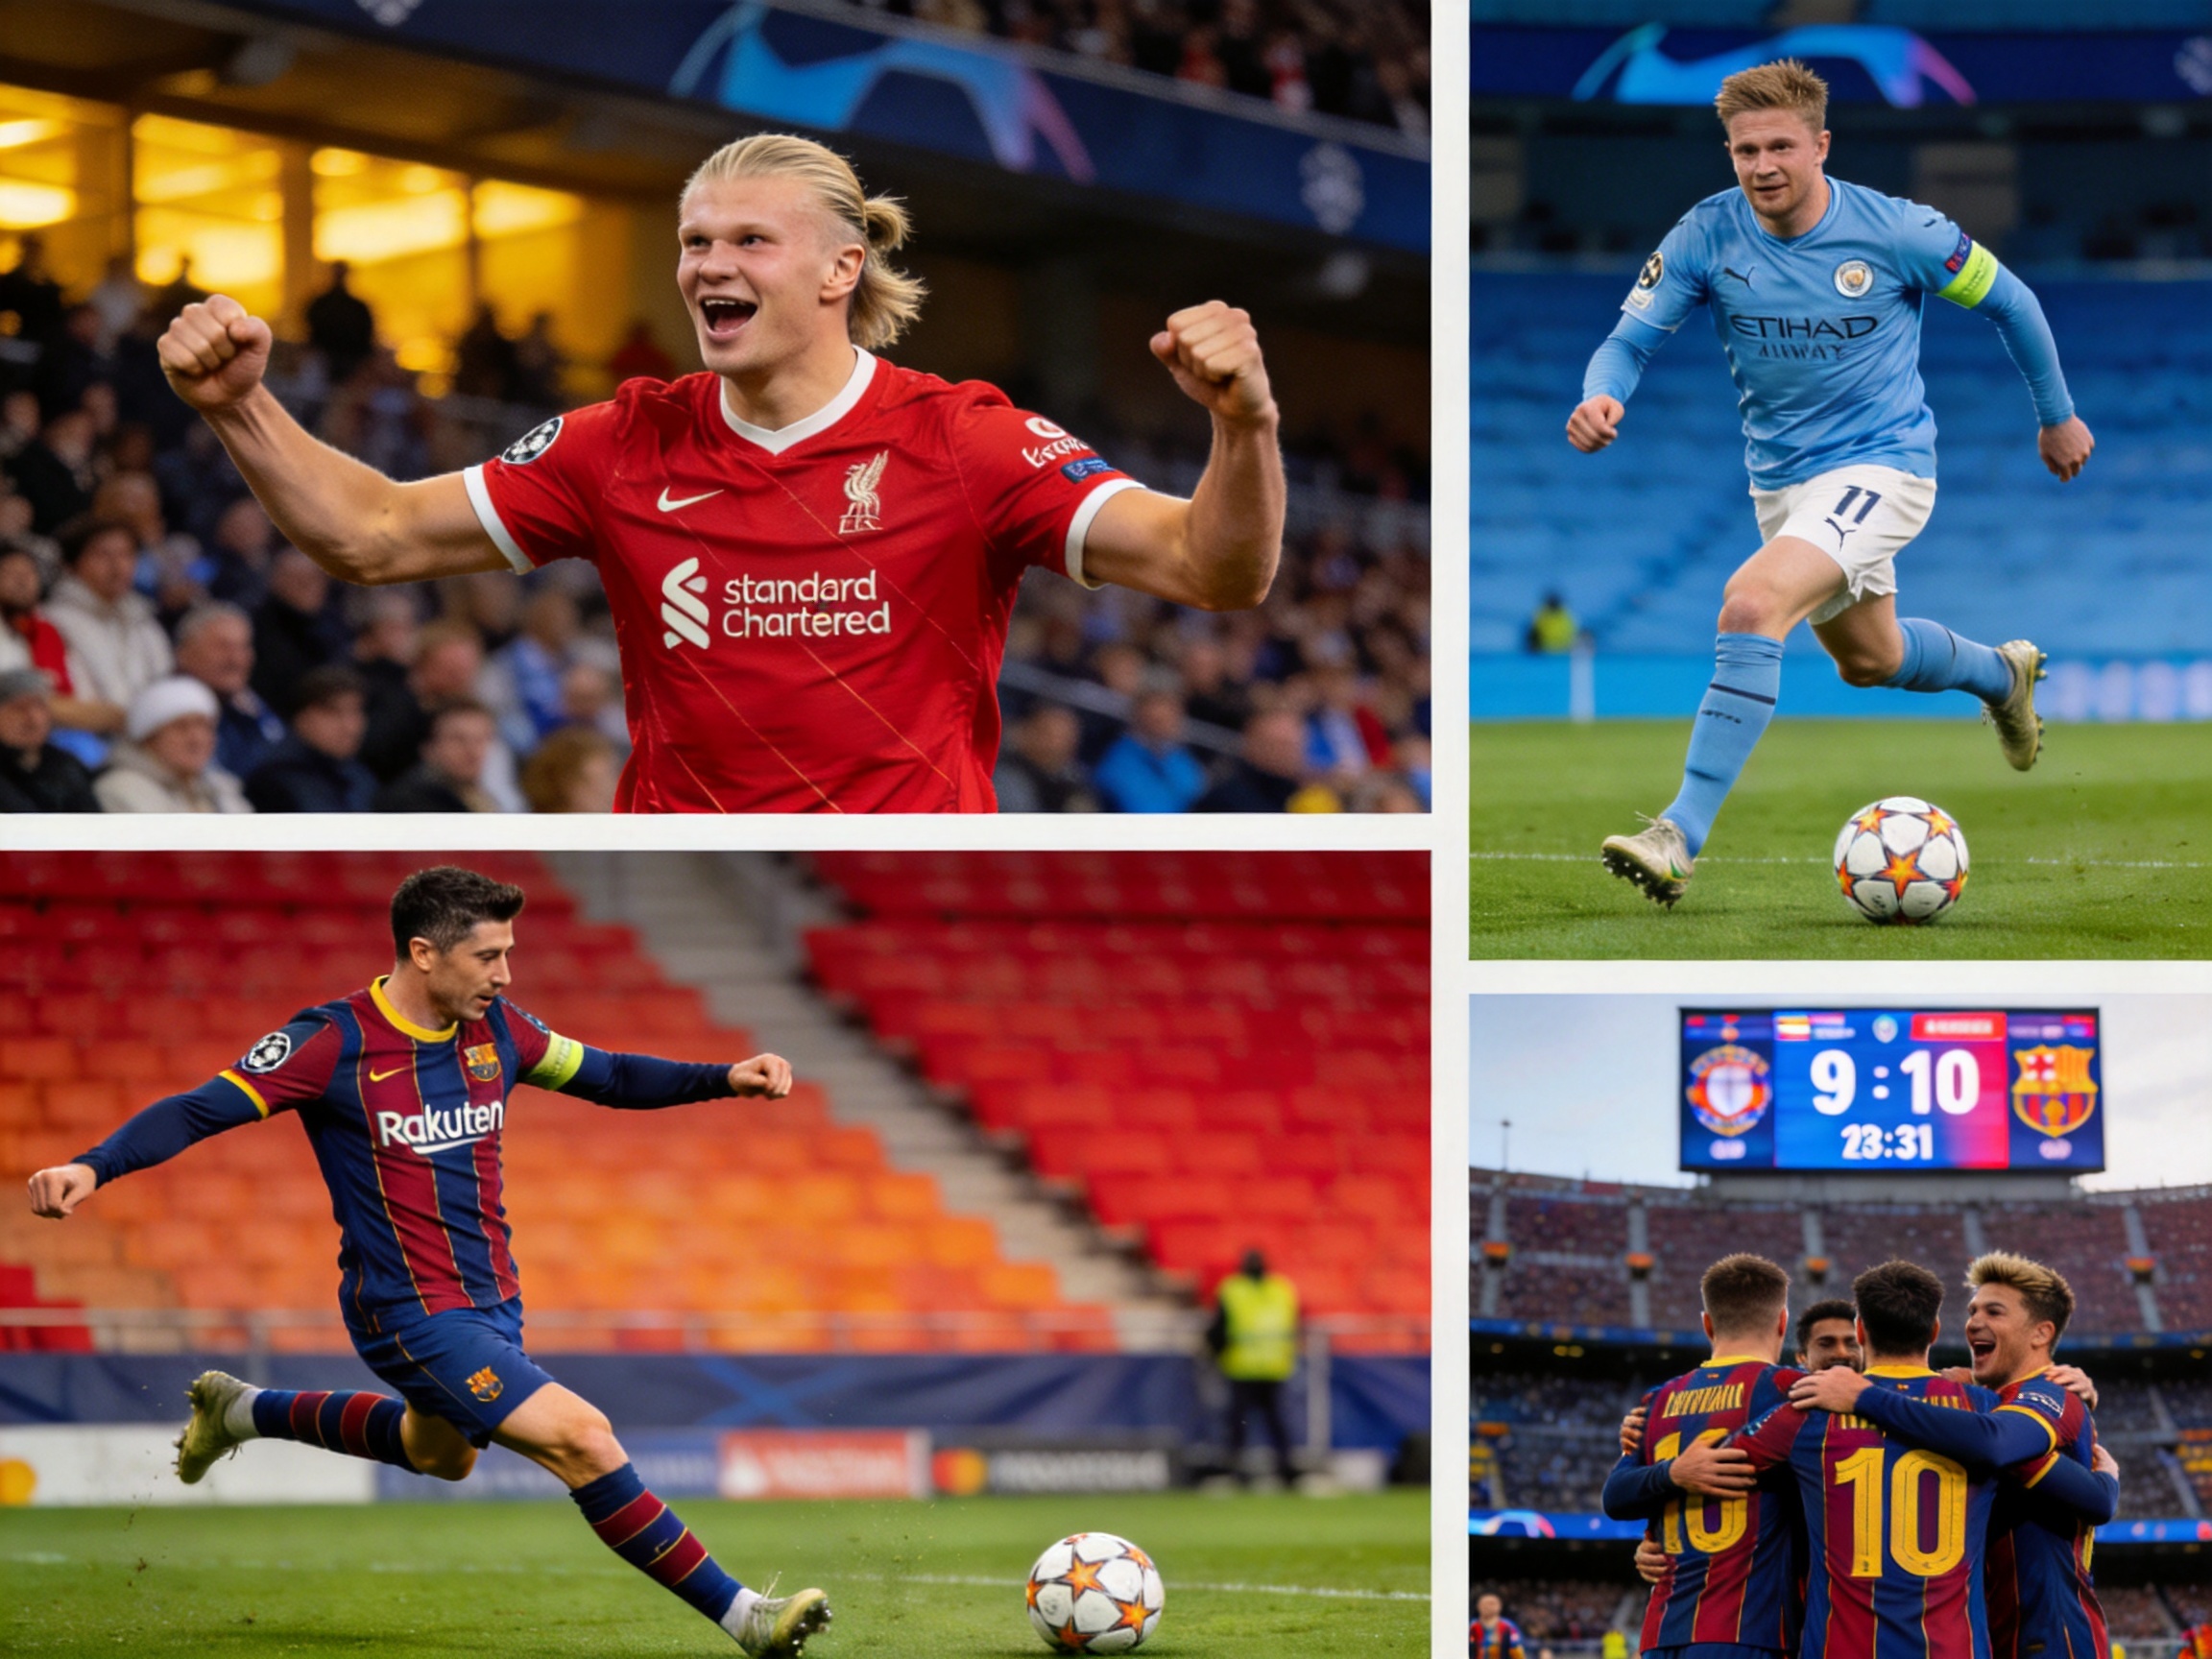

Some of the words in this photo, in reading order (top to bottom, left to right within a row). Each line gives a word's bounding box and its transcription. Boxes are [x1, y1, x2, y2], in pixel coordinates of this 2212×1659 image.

[1730, 315, 1878, 339] ETIHAD
[1833, 485, 1882, 524] 11
[722, 601, 891, 637] Chartered
[1810, 1048, 1857, 1116] 9
[1900, 1048, 1981, 1116] 10
[376, 1100, 504, 1146] Rakuten
[1840, 1122, 1934, 1161] 23:31
[1835, 1447, 1968, 1577] 10
